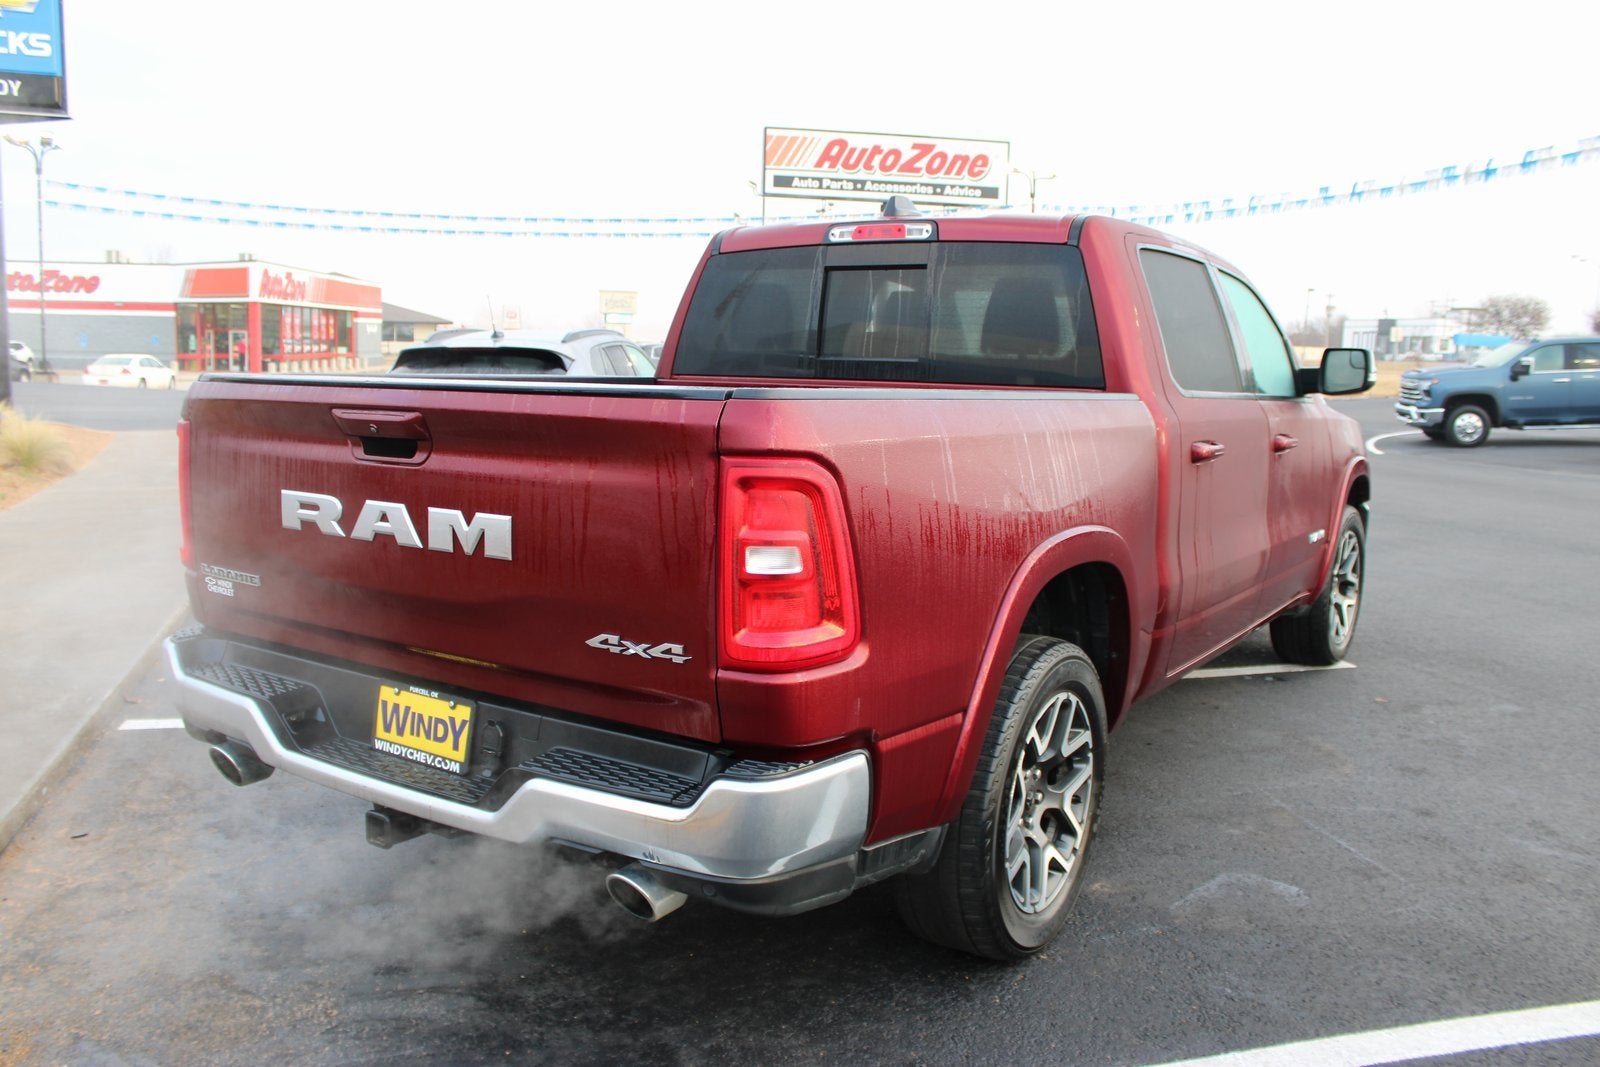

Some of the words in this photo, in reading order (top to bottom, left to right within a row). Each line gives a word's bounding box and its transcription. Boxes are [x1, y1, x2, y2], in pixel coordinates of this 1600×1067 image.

[813, 138, 990, 178] AutoZone
[791, 177, 819, 189] Auto
[822, 178, 854, 191] Parts
[863, 180, 934, 195] Accessories
[943, 185, 982, 197] Advice
[6, 270, 100, 294] toZone
[281, 489, 512, 561] RAM
[381, 699, 469, 752] WINDY
[374, 738, 461, 774] WINDYCHEV.COM
